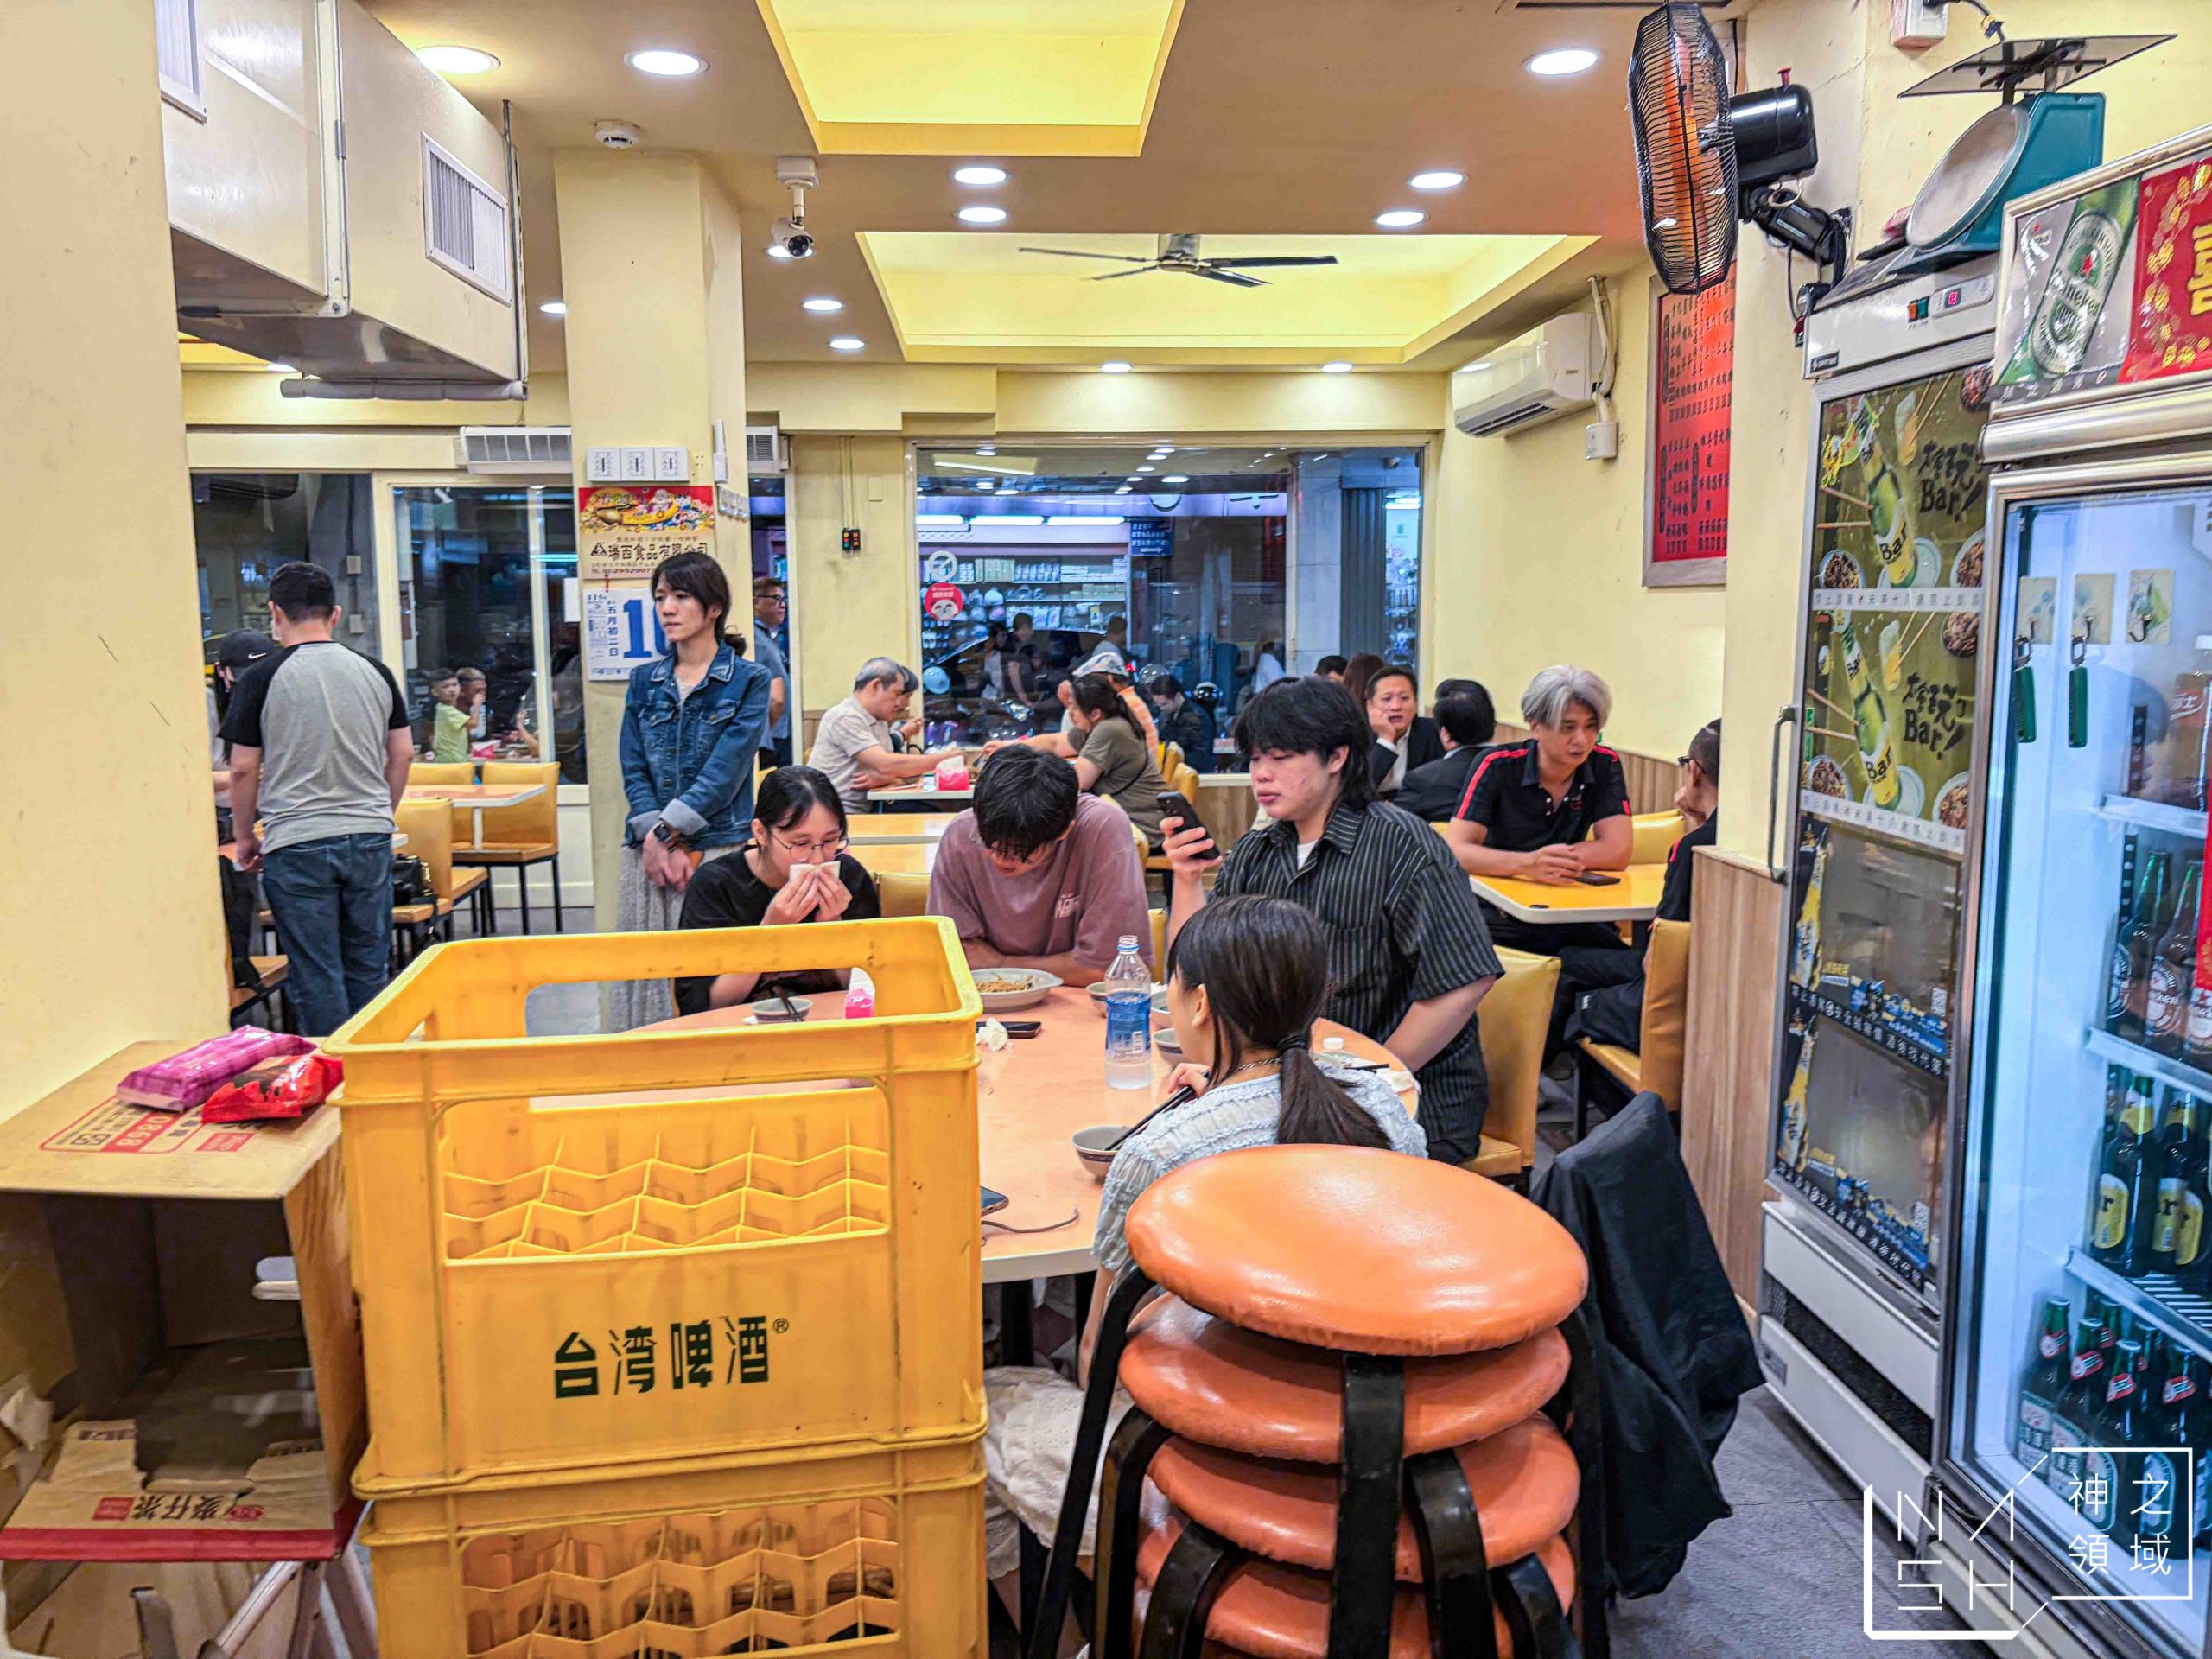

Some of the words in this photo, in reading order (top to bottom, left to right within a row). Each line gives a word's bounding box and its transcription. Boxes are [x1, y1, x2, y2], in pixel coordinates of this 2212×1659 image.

[607, 606, 620, 657] 五月初二日
[1903, 709, 1966, 760] Bar!
[1865, 746, 1893, 780] Bar
